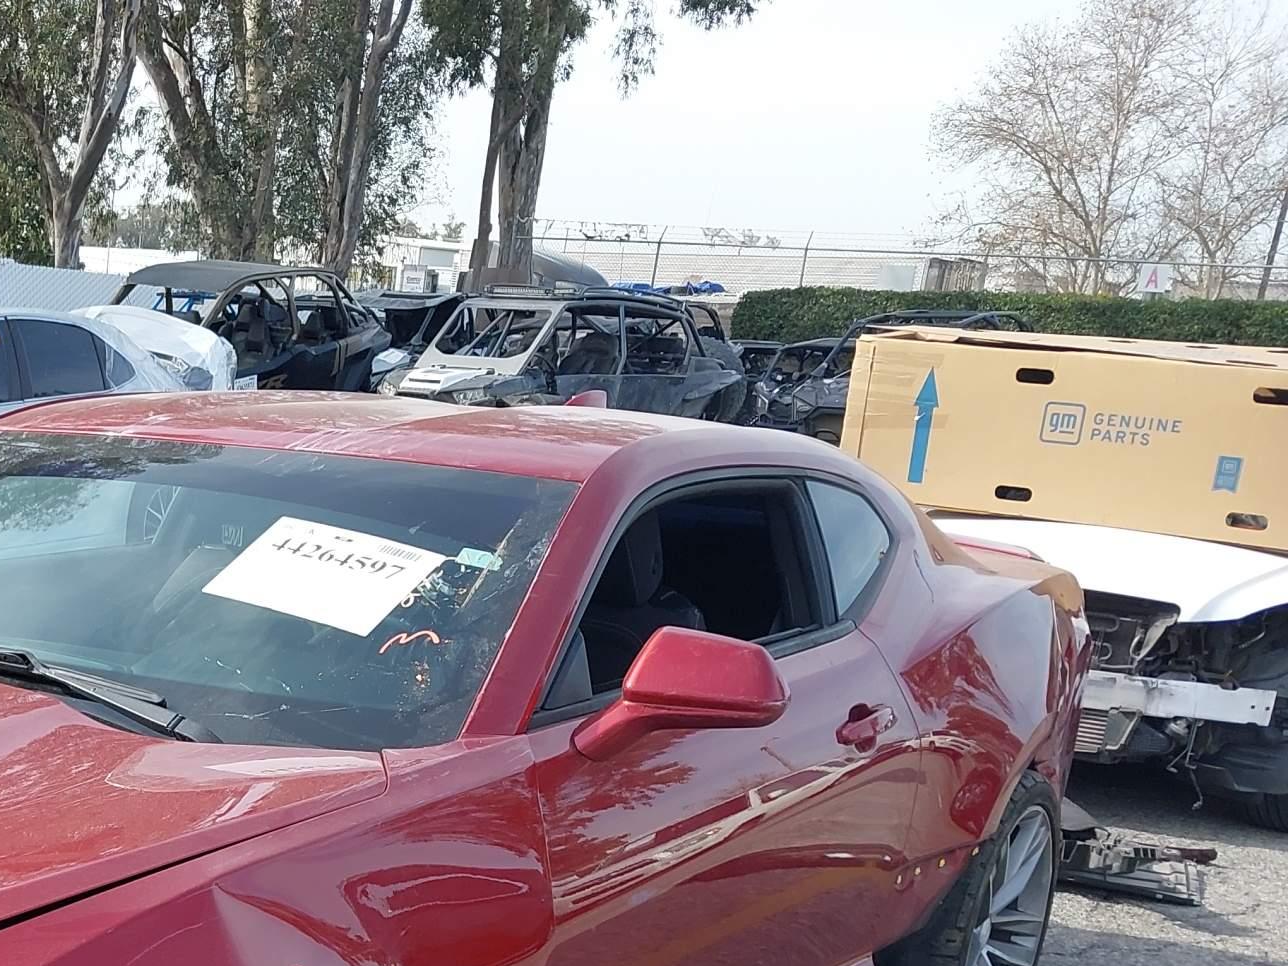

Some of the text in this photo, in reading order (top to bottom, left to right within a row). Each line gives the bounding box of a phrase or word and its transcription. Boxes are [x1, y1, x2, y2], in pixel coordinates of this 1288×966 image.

[1145, 266, 1158, 289] A
[1049, 412, 1077, 434] gm
[1093, 412, 1183, 434] GENUINE
[1090, 428, 1151, 446] PARTS
[272, 538, 407, 579] 44264597
